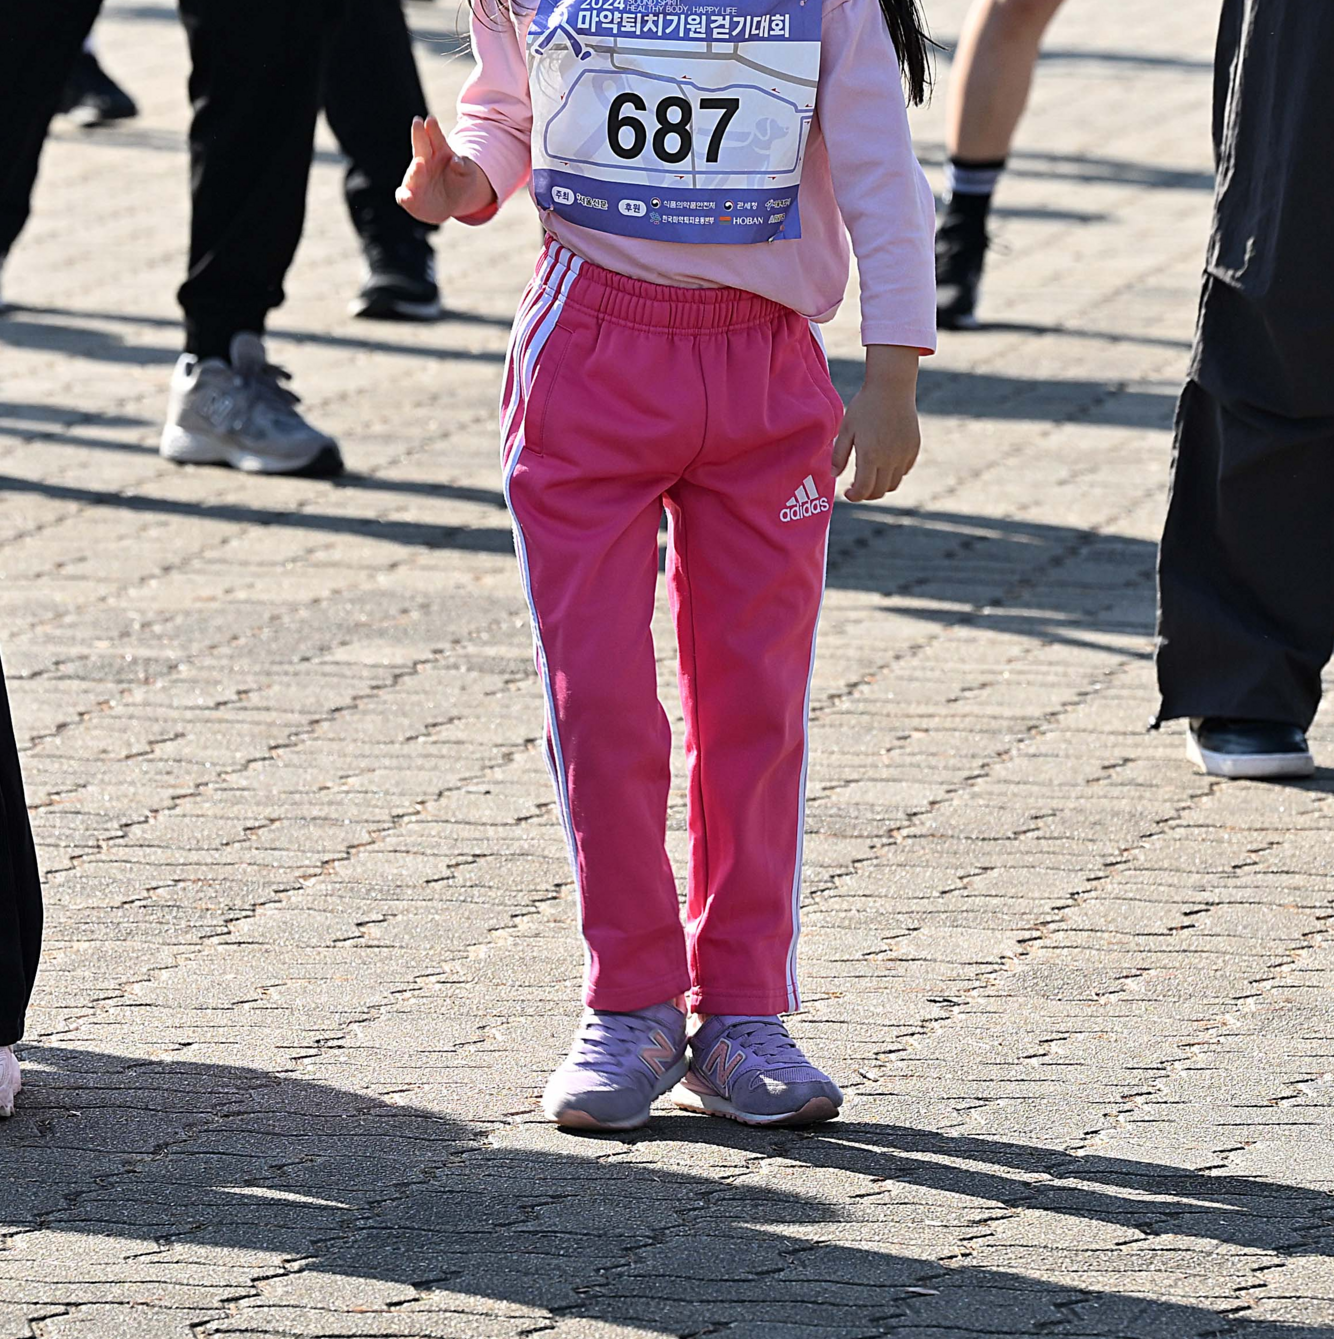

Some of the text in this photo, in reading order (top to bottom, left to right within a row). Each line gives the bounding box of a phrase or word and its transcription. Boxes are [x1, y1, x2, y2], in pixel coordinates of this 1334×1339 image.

[627, 4, 738, 15] HEALTHY BODY, HAPPY LIFE
[606, 92, 741, 164] 687
[554, 189, 571, 202] 주최
[623, 201, 642, 214] 후원
[732, 216, 764, 225] HOBAN
[779, 496, 830, 523] adidas
